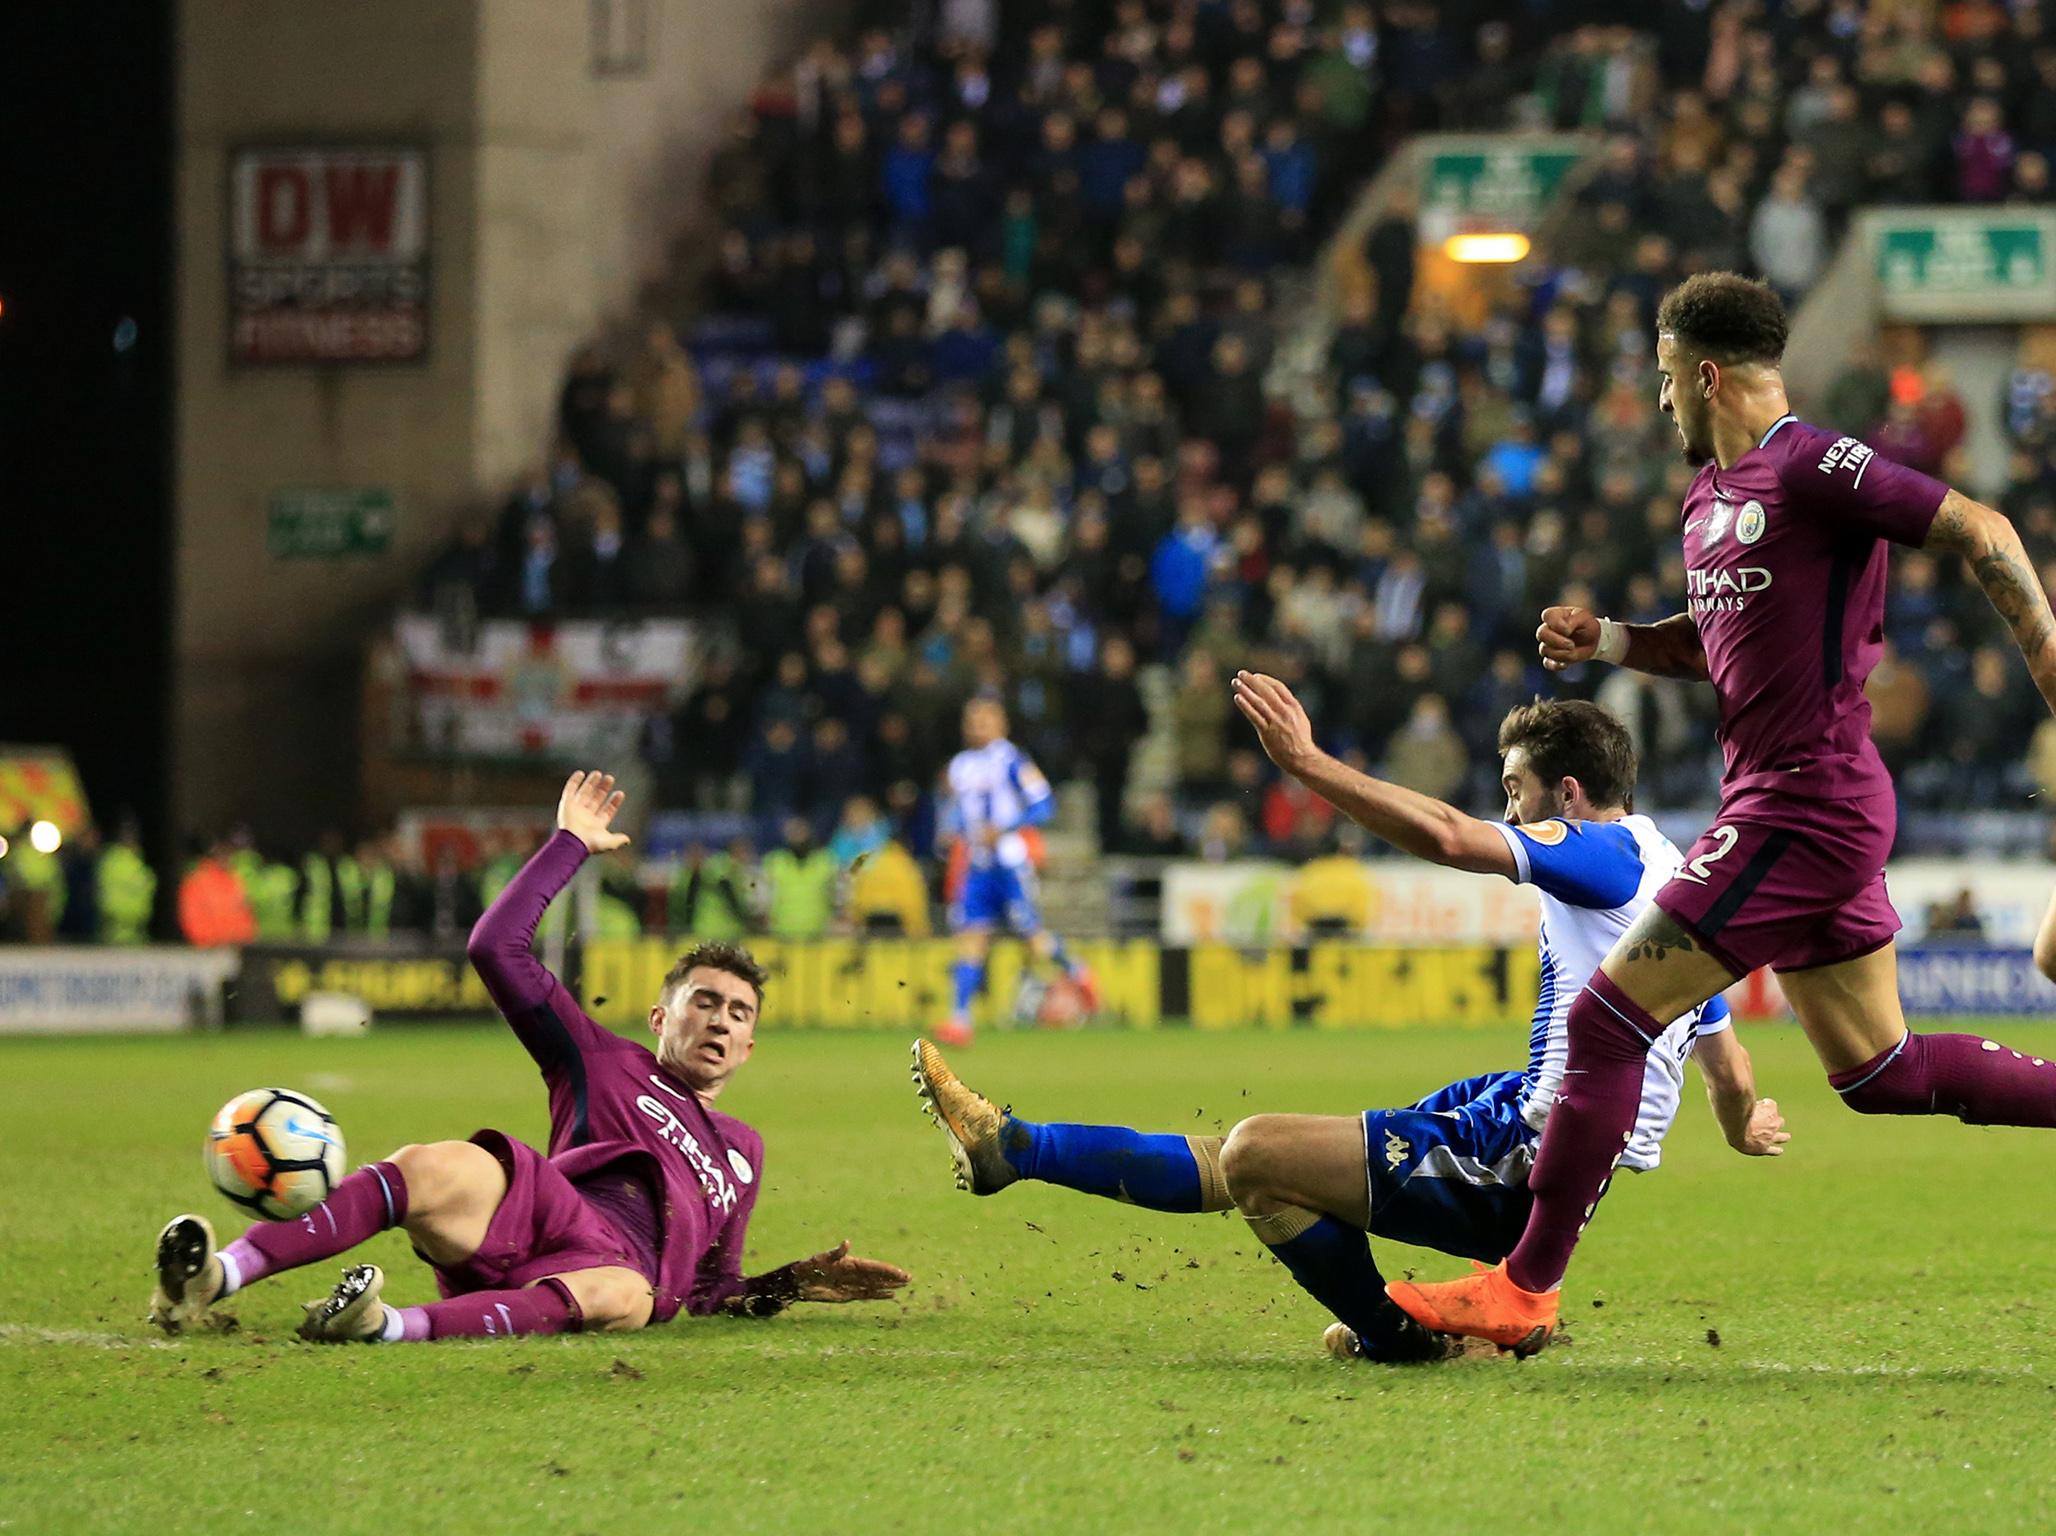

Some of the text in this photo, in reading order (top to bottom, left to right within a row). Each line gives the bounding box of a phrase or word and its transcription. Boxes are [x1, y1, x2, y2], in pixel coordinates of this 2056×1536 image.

[257, 165, 404, 252] DW
[236, 268, 424, 301] SPORTS
[1817, 437, 1860, 475] NEXE
[1687, 566, 1773, 595] TIHAD
